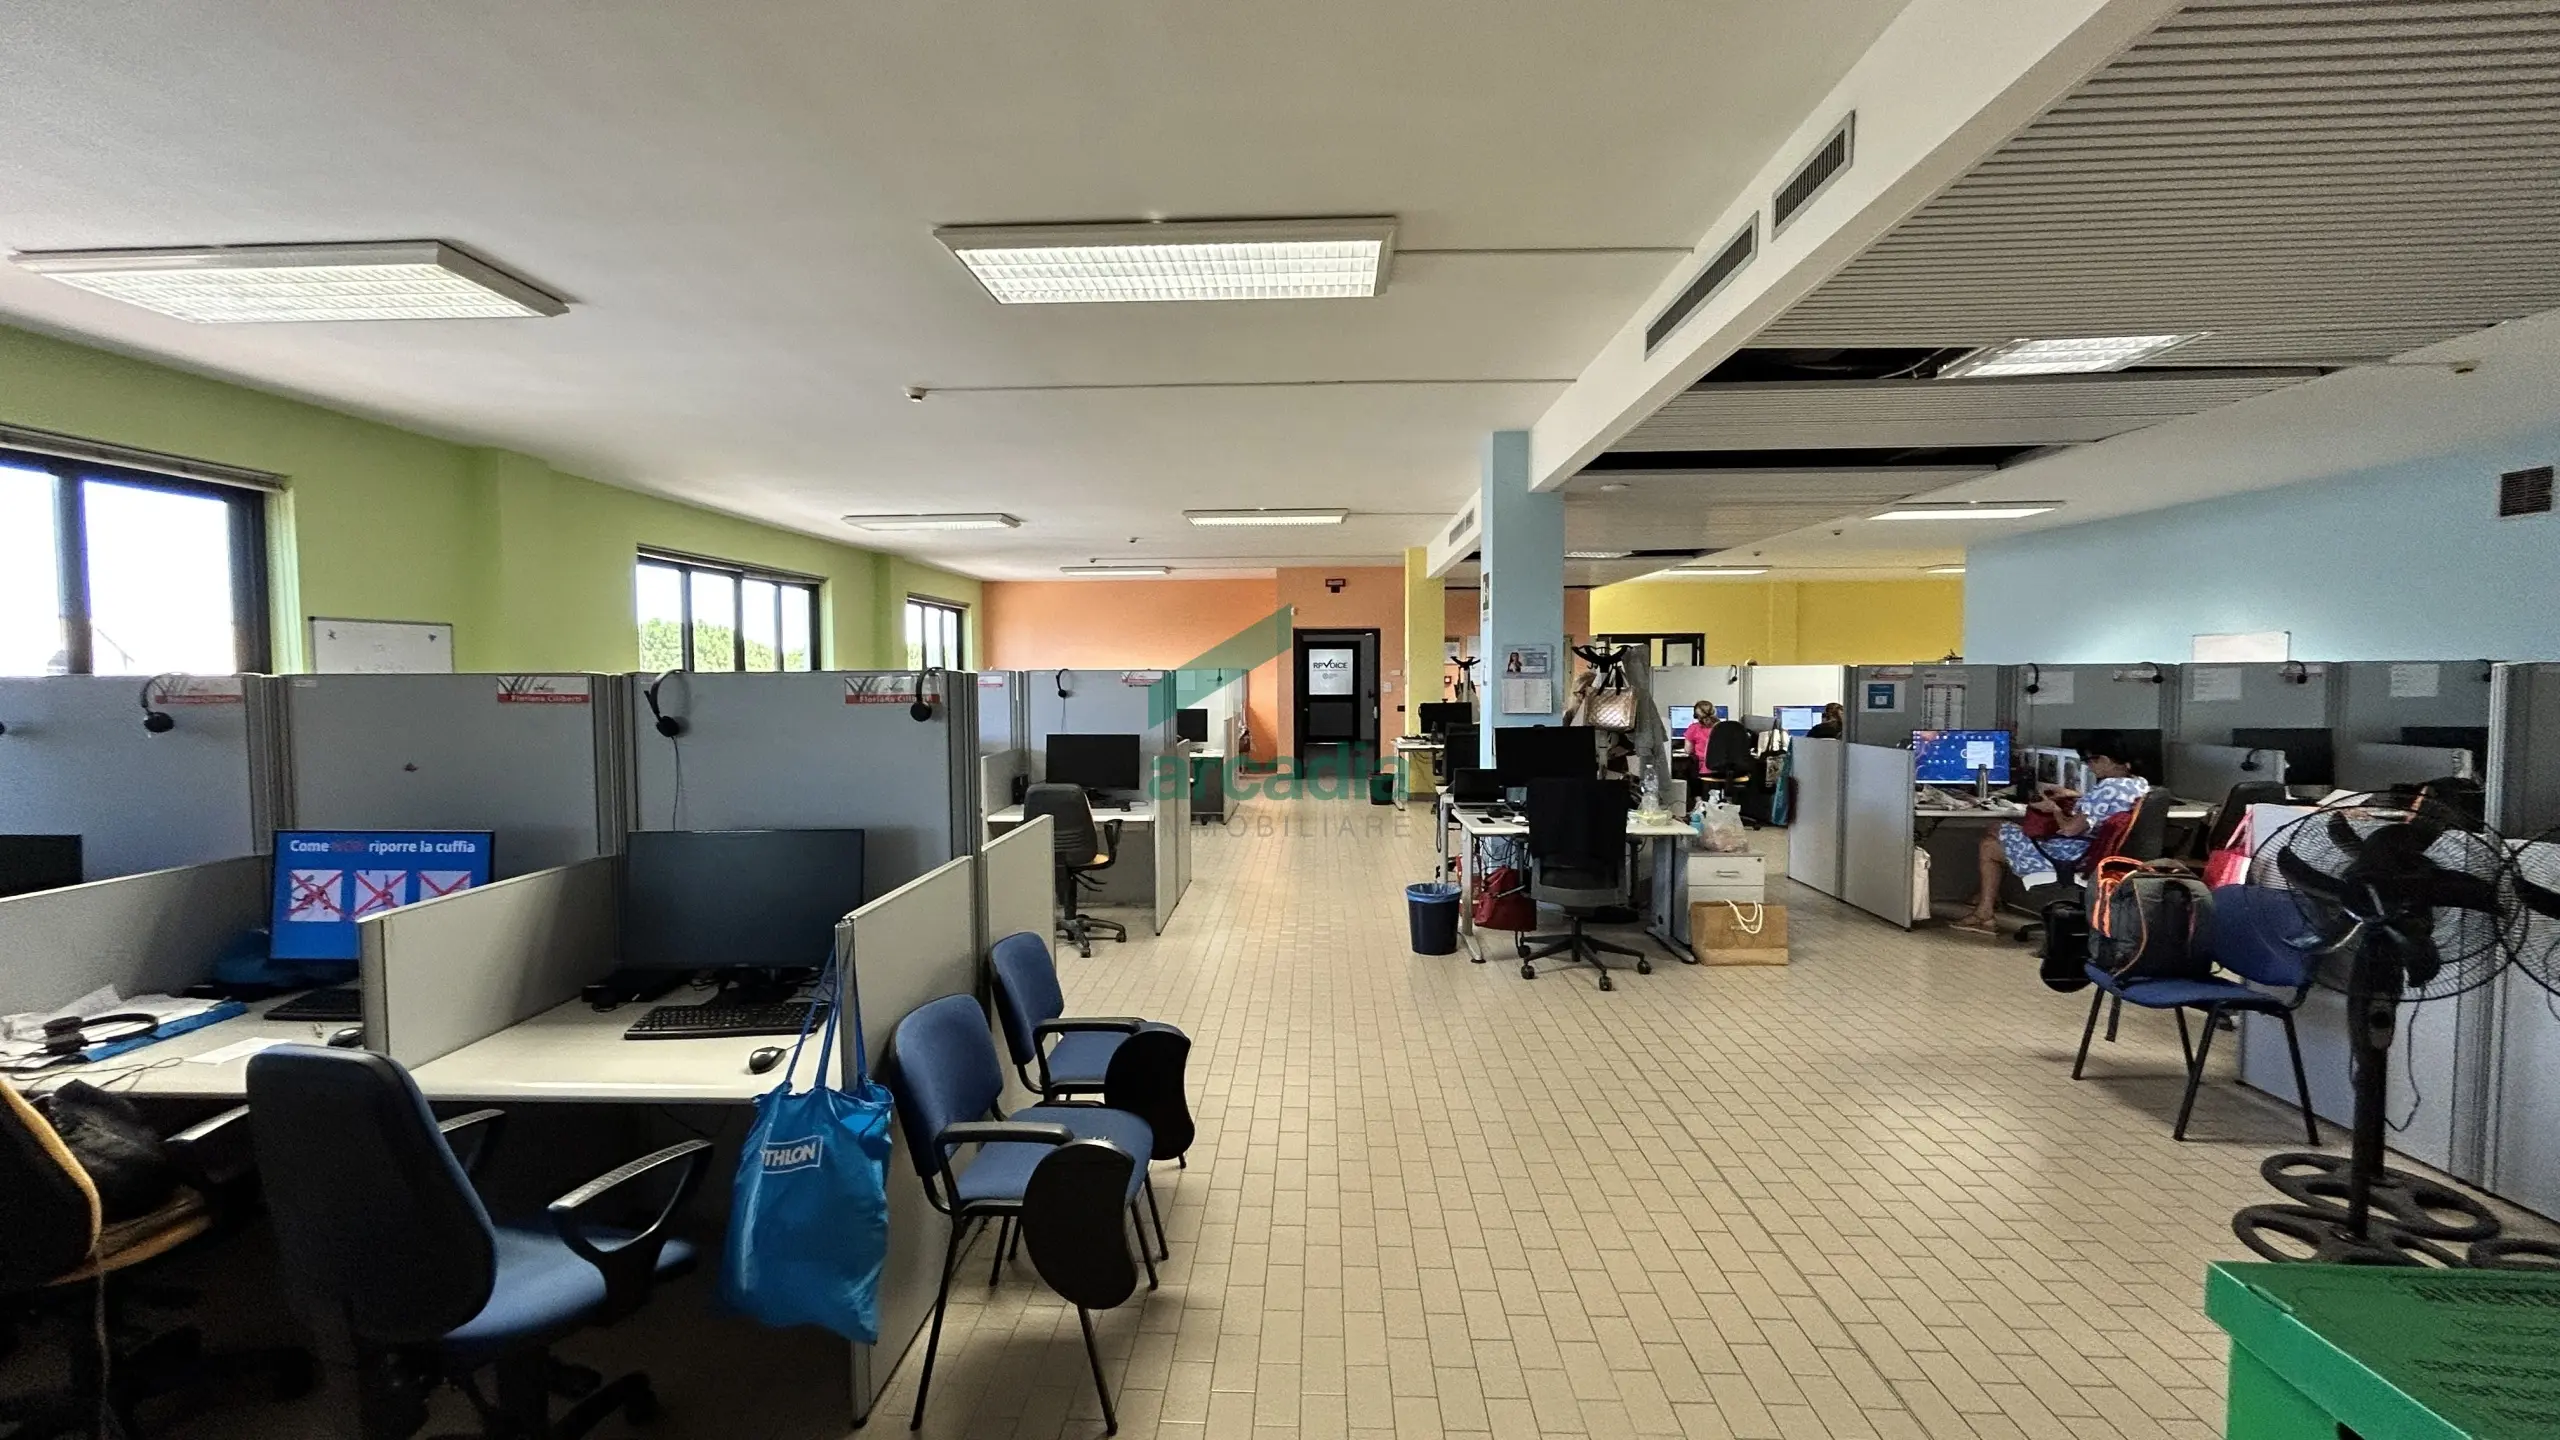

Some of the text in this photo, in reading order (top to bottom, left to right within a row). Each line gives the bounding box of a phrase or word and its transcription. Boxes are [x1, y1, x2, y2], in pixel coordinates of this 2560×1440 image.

[290, 840, 330, 853] Come
[368, 840, 417, 855] riporre
[420, 840, 434, 853] la
[436, 840, 476, 853] cuffia
[762, 1140, 817, 1167] THLON
